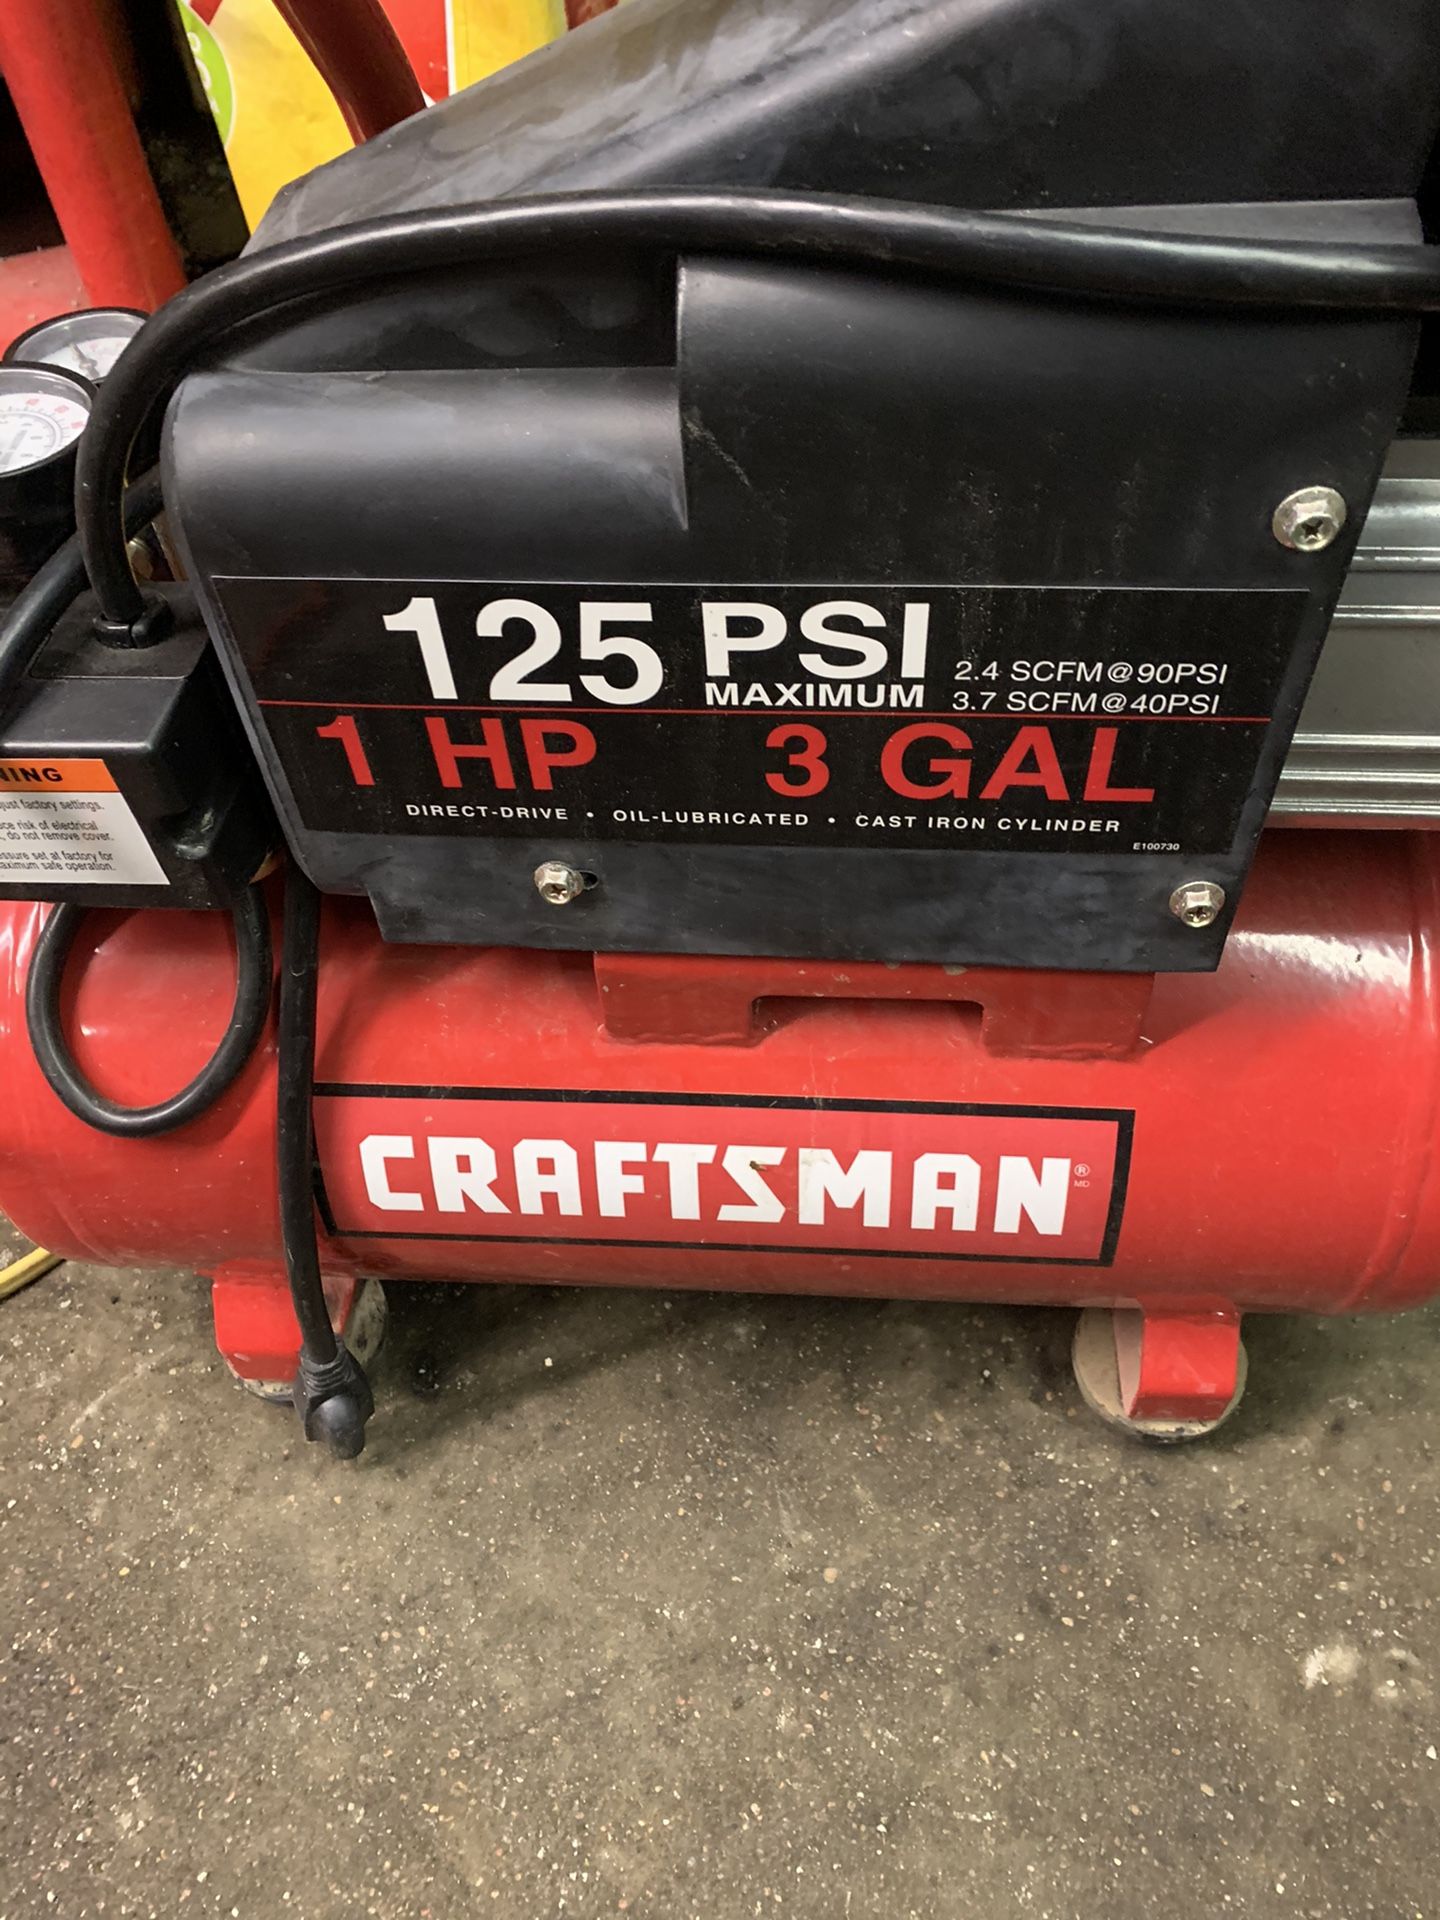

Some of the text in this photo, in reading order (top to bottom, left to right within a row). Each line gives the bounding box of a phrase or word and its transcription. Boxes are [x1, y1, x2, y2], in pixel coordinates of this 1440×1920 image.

[383, 597, 930, 705] 125 PSI
[954, 660, 999, 681] 2.4
[705, 682, 925, 708] MAXIMUM
[952, 691, 997, 711] 3.7
[316, 714, 597, 790] 1 HP
[765, 722, 1155, 802] 3 GAL
[20, 799, 57, 812] factory
[59, 799, 105, 812] settings.
[17, 820, 37, 830] risk
[38, 820, 50, 830] of
[51, 820, 98, 831] electrical
[406, 804, 1121, 833] DIRECT-DRIVE OIL-LUBRICATED CAST IRON CYLINDER
[7, 831, 21, 840] do
[22, 831, 40, 840] not
[41, 832, 80, 841] remove
[31, 851, 48, 861] set
[61, 850, 97, 862] factory
[98, 850, 114, 861] for
[1132, 842, 1181, 851] E100730
[41, 861, 63, 870] safe
[359, 1134, 1071, 1236] CRAFTSMAN
